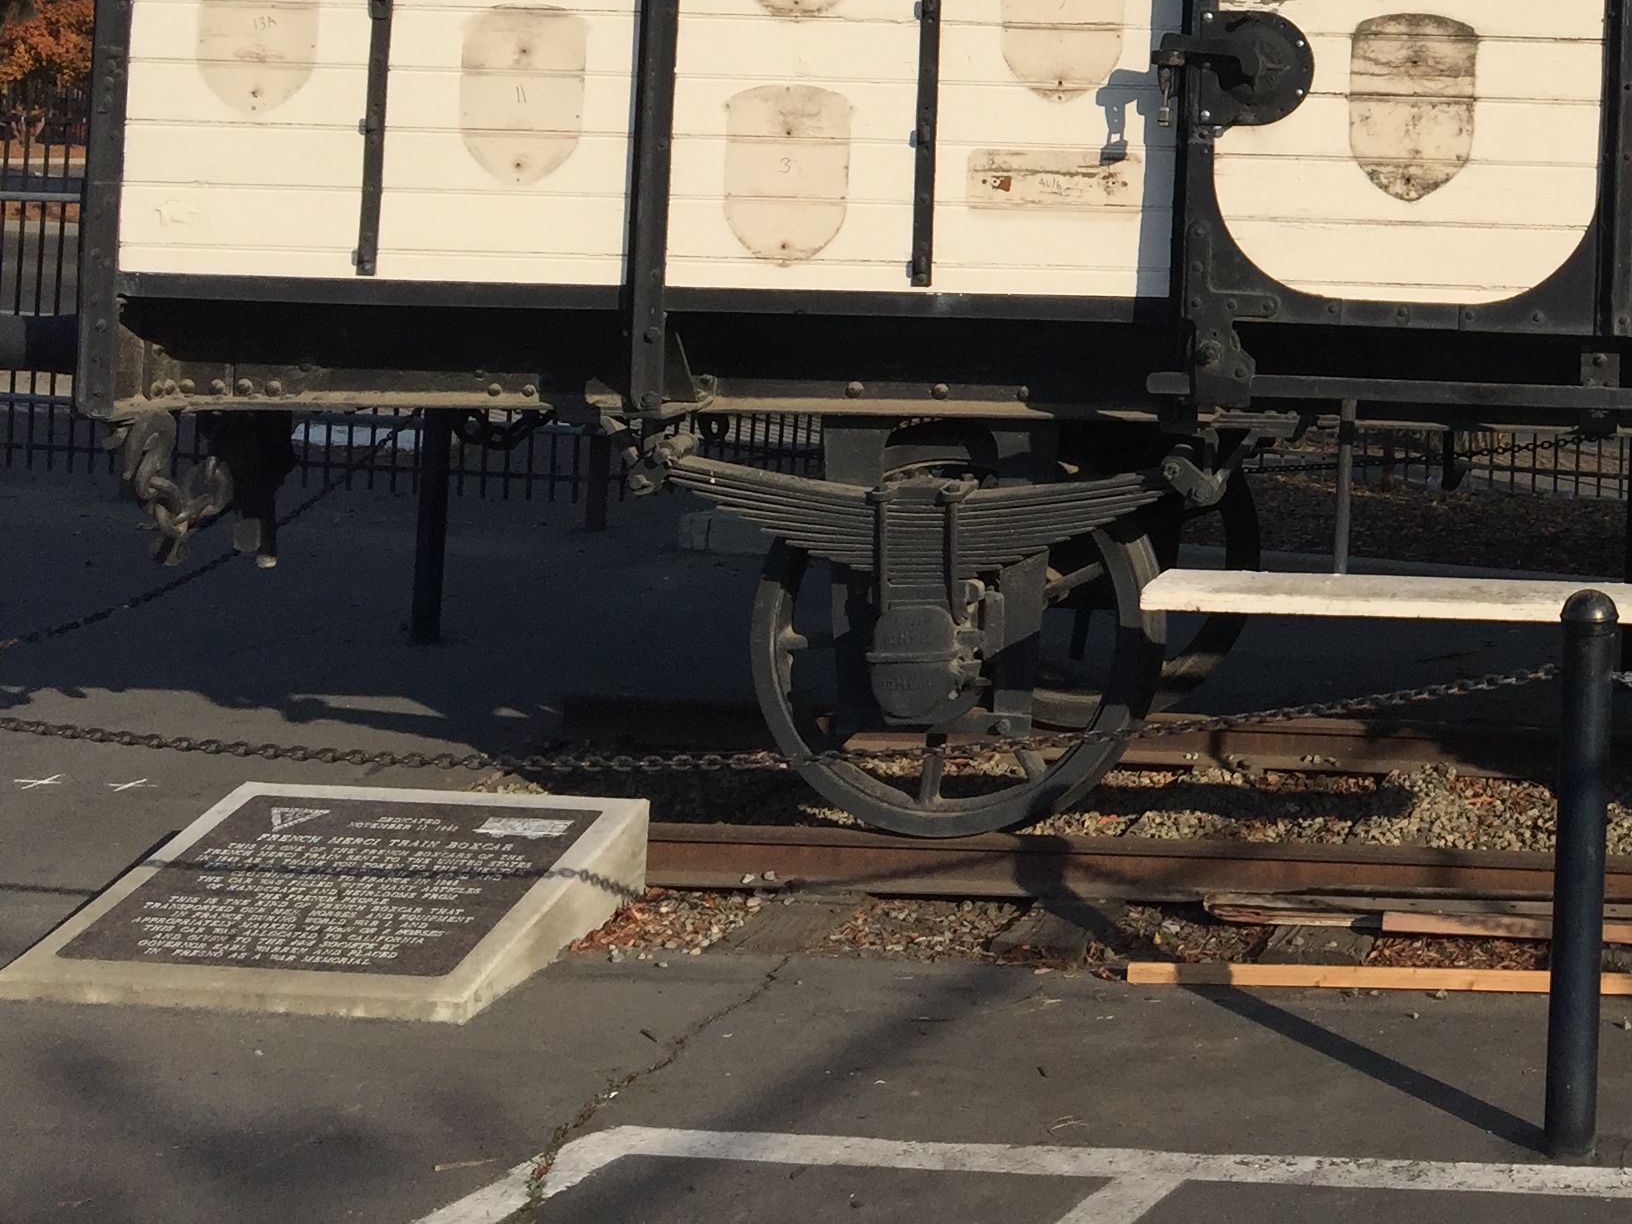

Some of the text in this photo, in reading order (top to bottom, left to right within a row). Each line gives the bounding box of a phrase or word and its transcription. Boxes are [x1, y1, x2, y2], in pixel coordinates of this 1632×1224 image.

[778, 156, 791, 174] 3
[257, 832, 514, 851] FRENCH MERCI TRAIN BOXCAR
